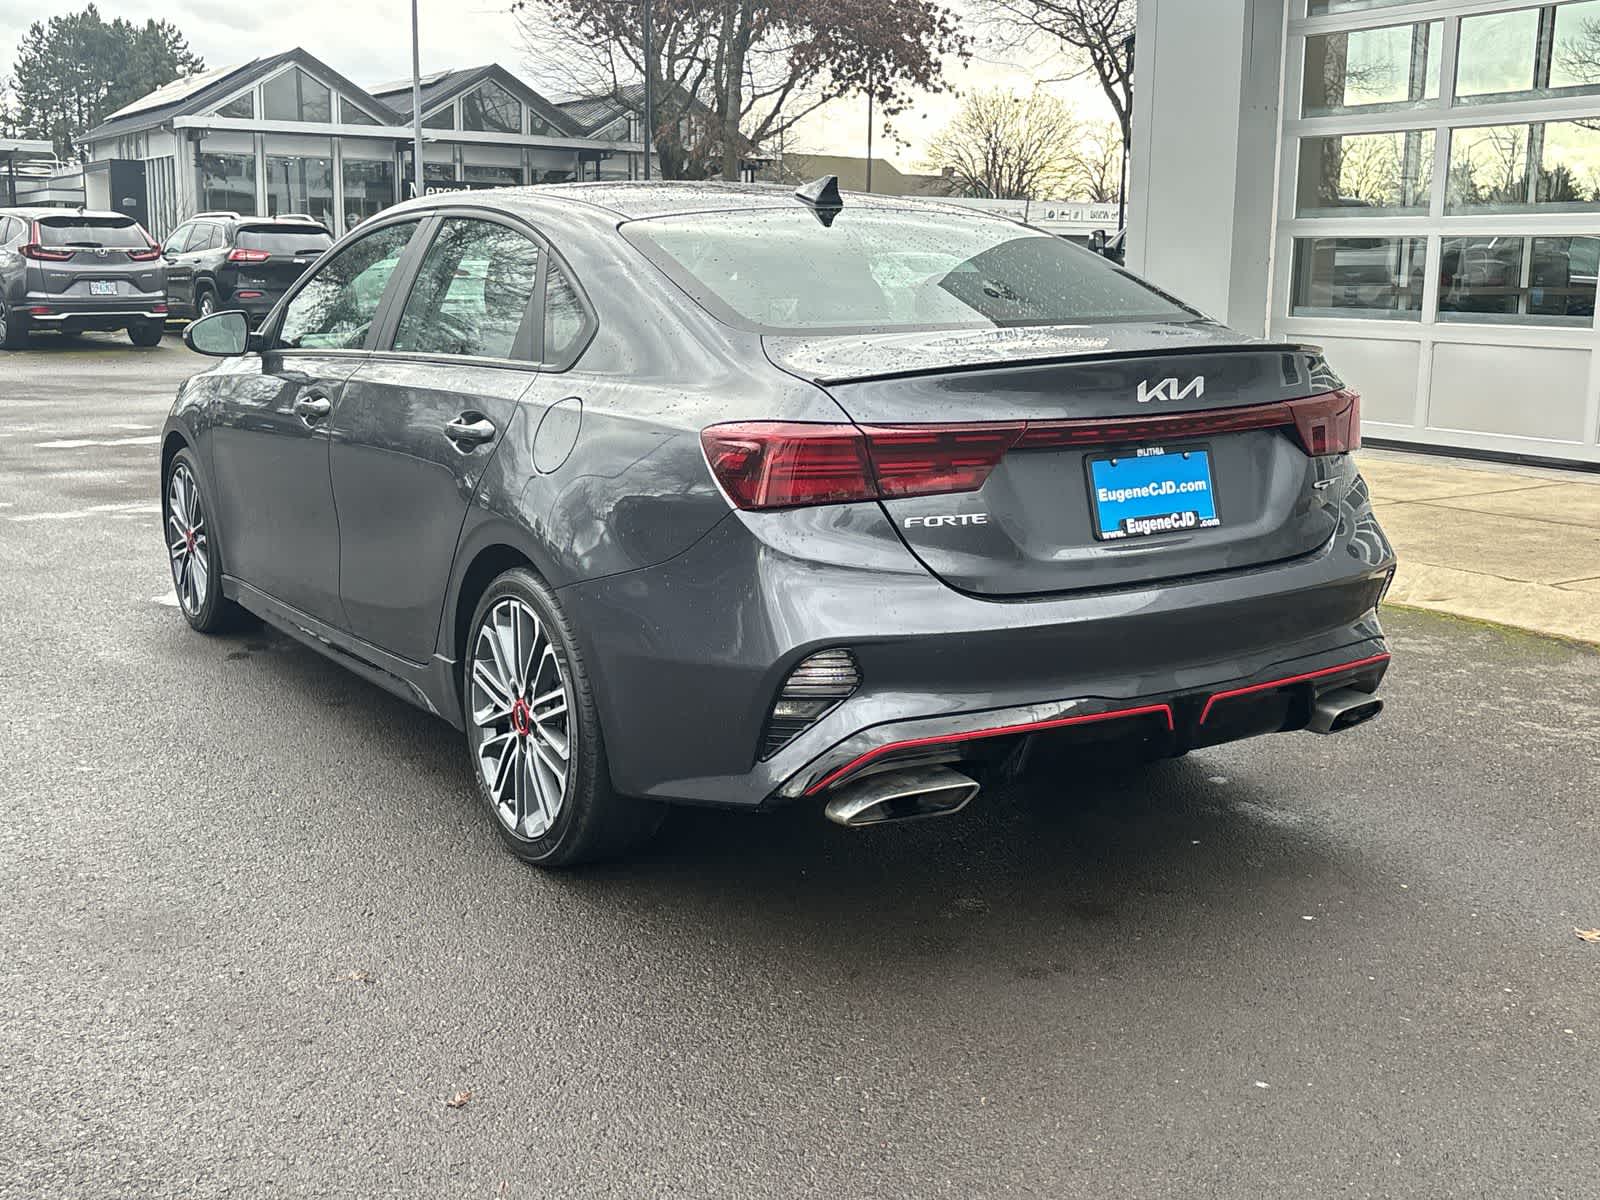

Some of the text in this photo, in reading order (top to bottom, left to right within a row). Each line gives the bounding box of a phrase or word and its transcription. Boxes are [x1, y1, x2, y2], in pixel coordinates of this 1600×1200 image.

[1137, 376, 1204, 403] KIA
[1098, 480, 1207, 503] EugeneCJD.com
[904, 513, 988, 529] FORTE
[1126, 511, 1195, 535] EugeneCJD
